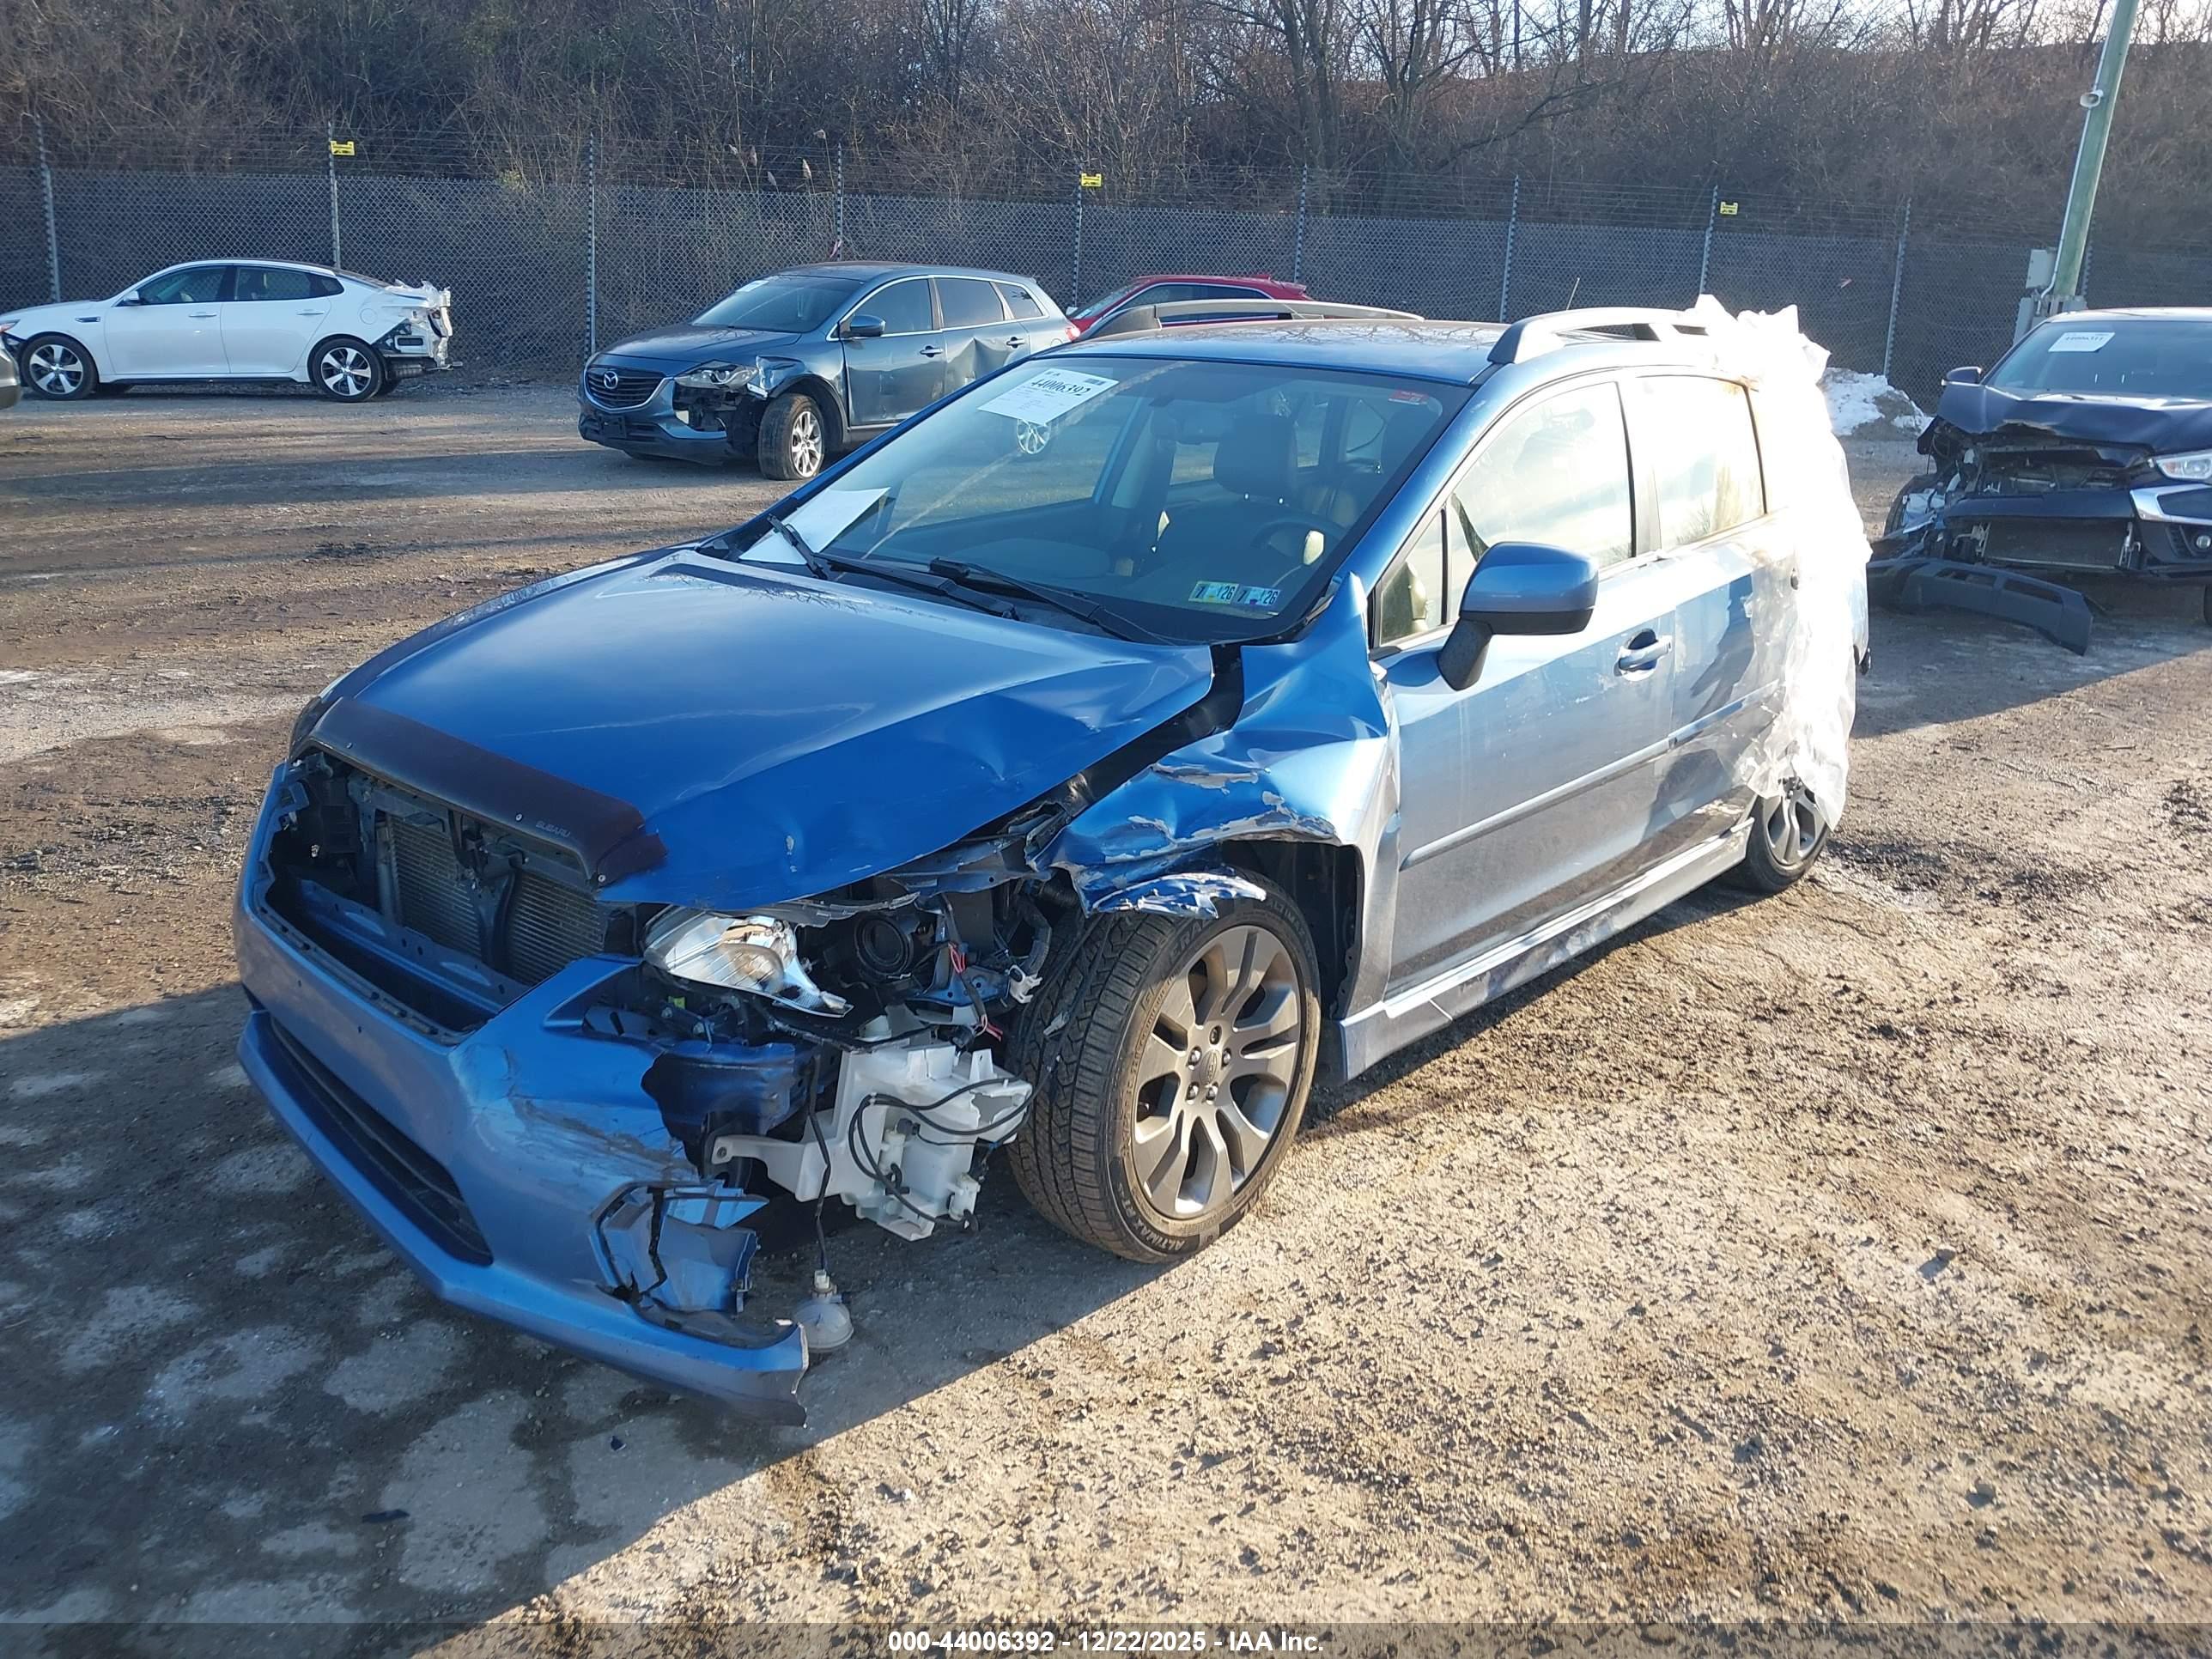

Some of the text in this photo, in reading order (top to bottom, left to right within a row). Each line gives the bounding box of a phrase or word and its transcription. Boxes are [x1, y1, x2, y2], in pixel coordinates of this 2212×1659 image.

[1030, 378, 1091, 397] 44006392
[1220, 586, 1236, 600] 26
[1262, 590, 1279, 605] 26
[535, 820, 571, 838] SUBARU
[1133, 1218, 1186, 1251] ALTIMAX
